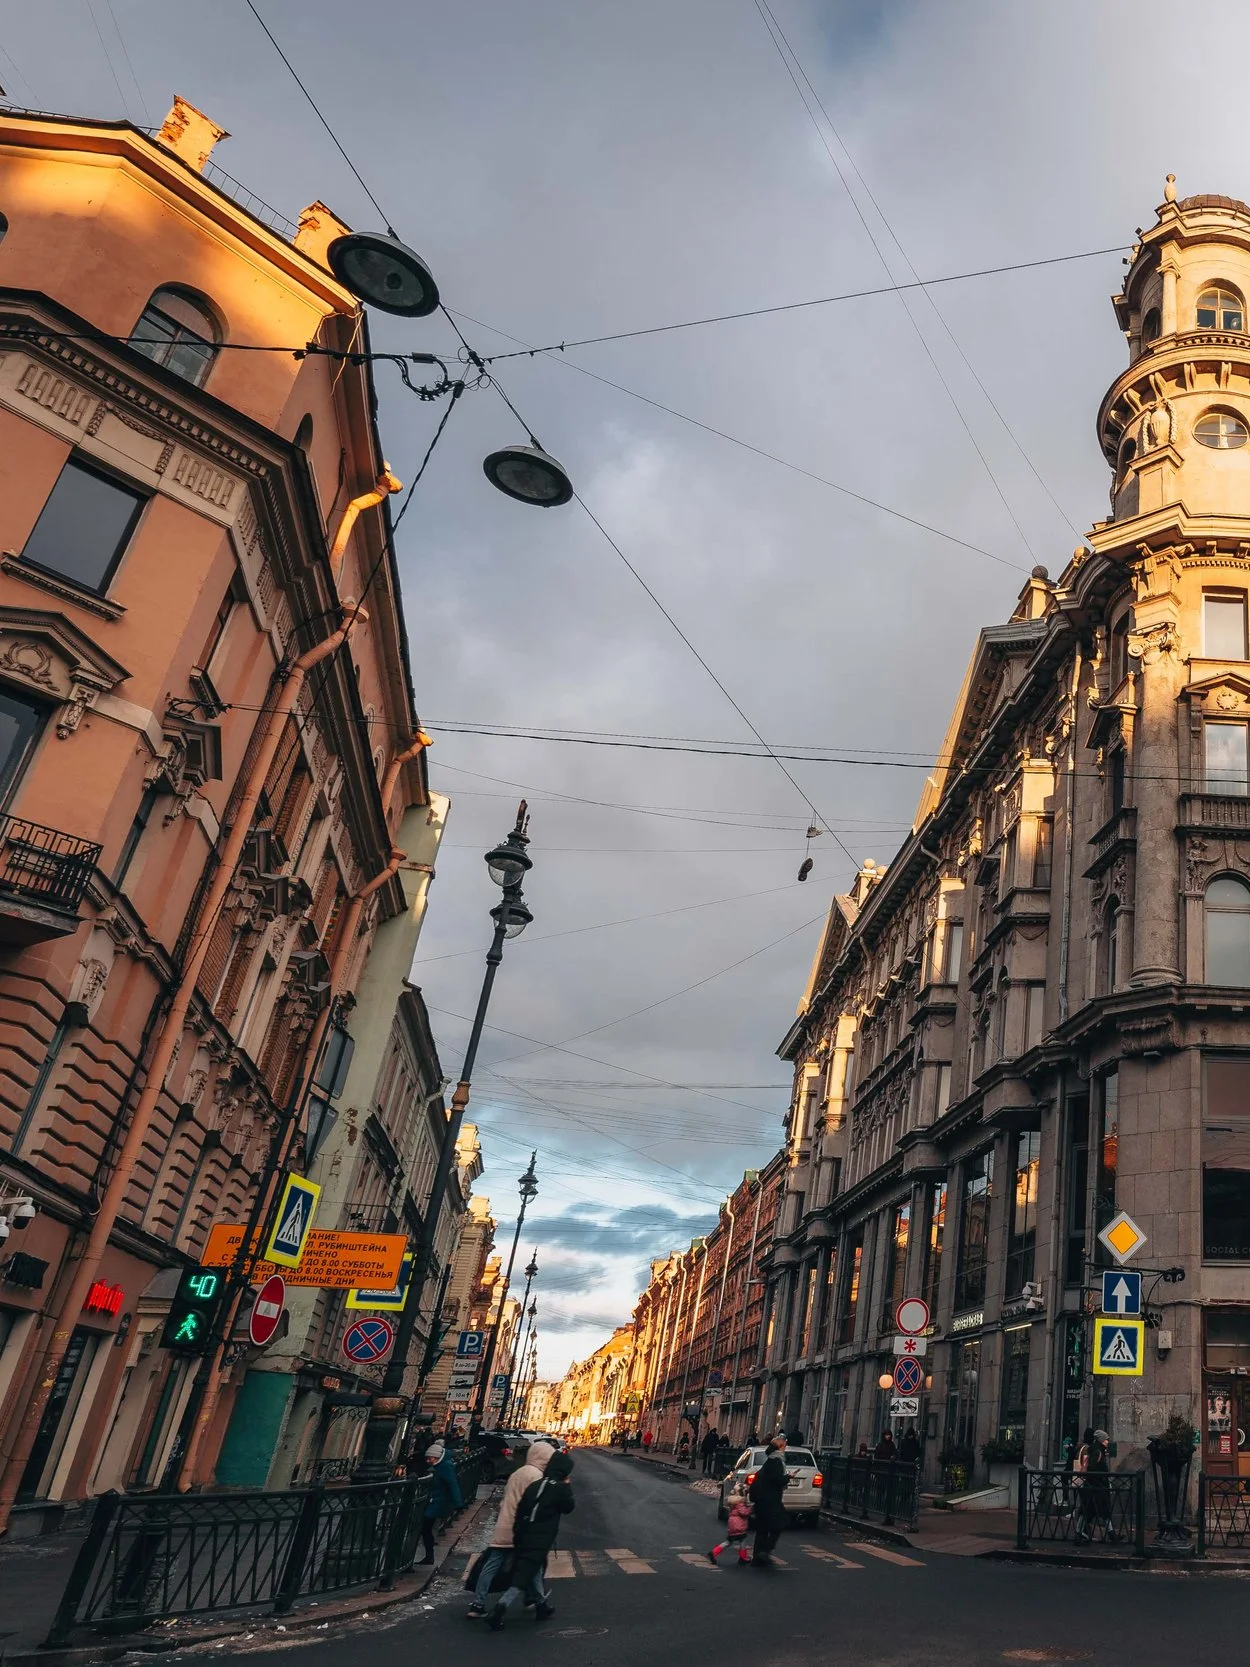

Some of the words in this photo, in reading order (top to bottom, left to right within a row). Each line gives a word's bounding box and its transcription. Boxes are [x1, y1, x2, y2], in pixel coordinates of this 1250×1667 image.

[318, 1242, 387, 1253] РУБИНШТЕЙНА
[1206, 1246, 1240, 1254] SOCIAL
[305, 1259, 320, 1267] ДО
[321, 1259, 340, 1268] 8.00
[341, 1260, 385, 1270] СУББОТЫ
[305, 1267, 324, 1275] 8.00
[325, 1268, 394, 1279] ВОСКРЕСЕНЬЯ
[189, 1275, 217, 1298] 40
[334, 1277, 355, 1286] ДНИ
